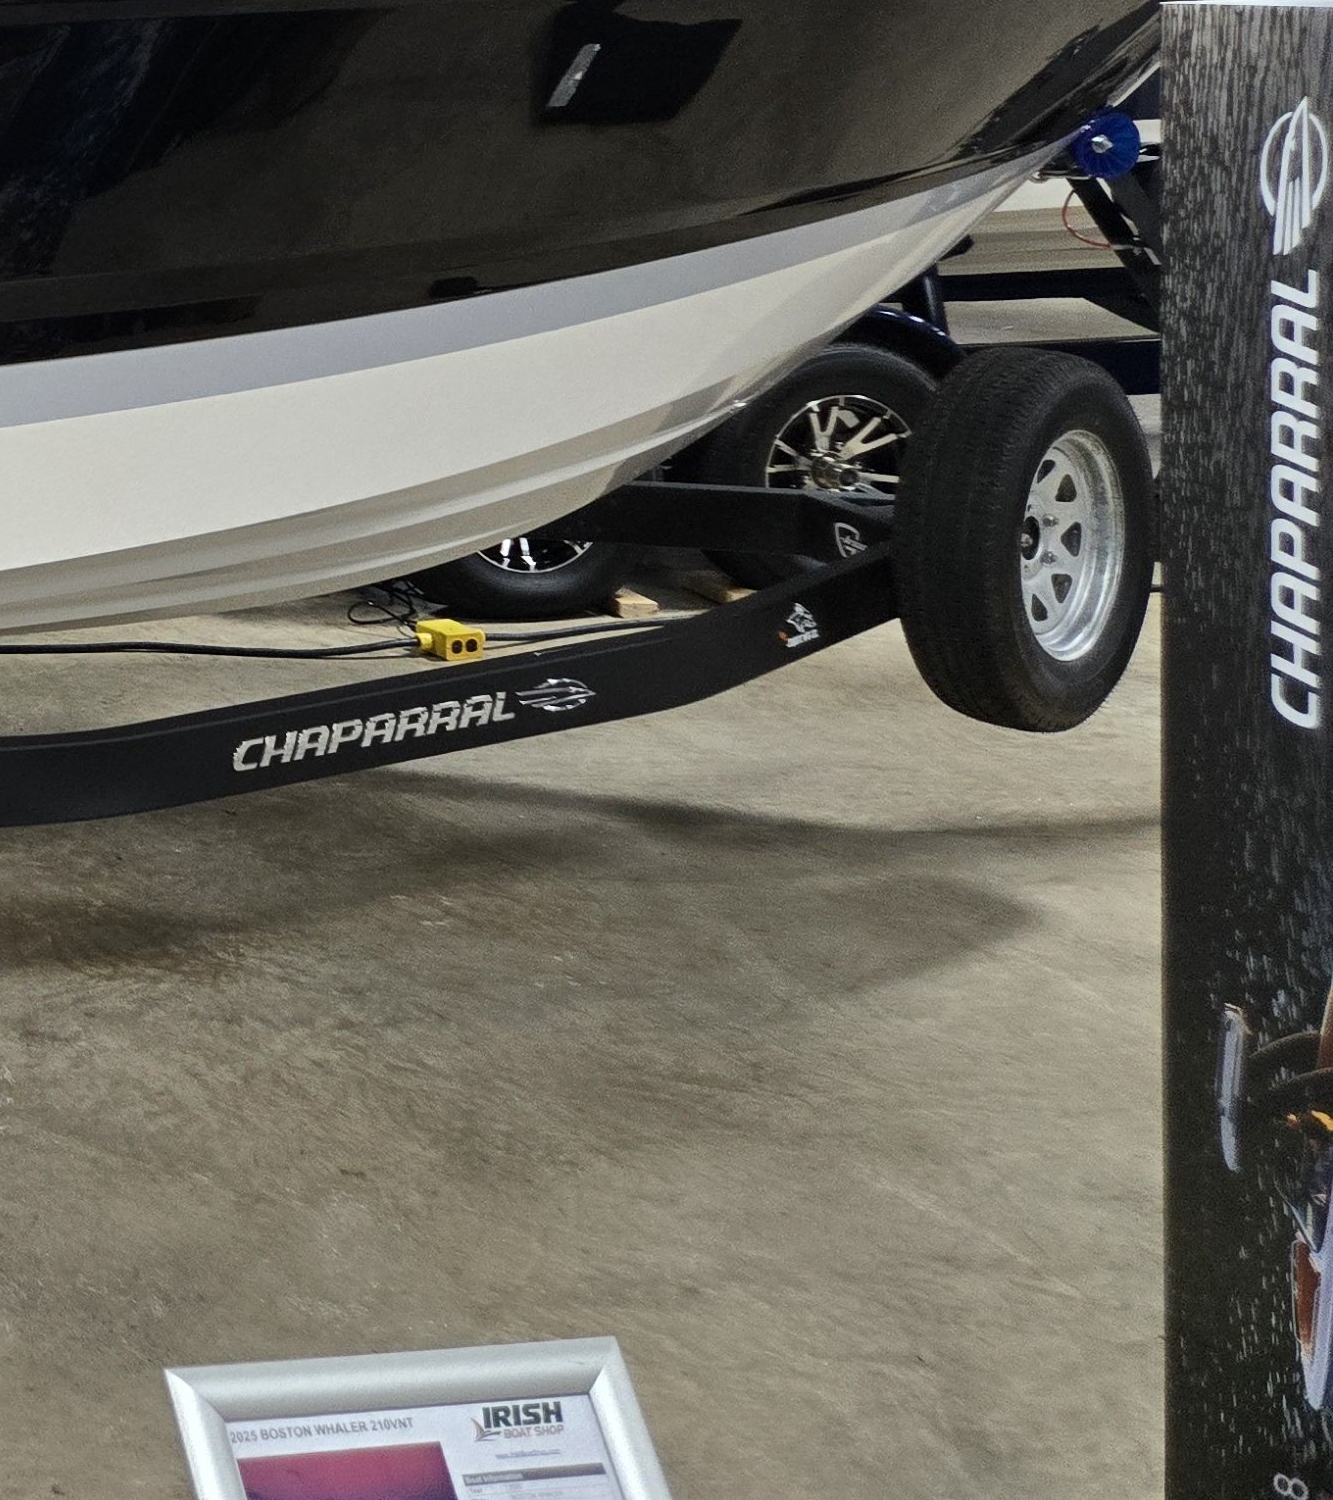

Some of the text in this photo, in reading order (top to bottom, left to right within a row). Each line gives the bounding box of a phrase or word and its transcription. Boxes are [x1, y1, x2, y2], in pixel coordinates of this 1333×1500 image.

[1271, 269, 1320, 730] CHAPARRAL
[233, 691, 516, 772] CHAPARRAL
[482, 1401, 564, 1429] IRISH
[230, 1430, 258, 1444] 2025
[260, 1426, 312, 1441] BOSTON
[314, 1421, 368, 1436] WHALER
[504, 1425, 564, 1439] BOAT SHOP
